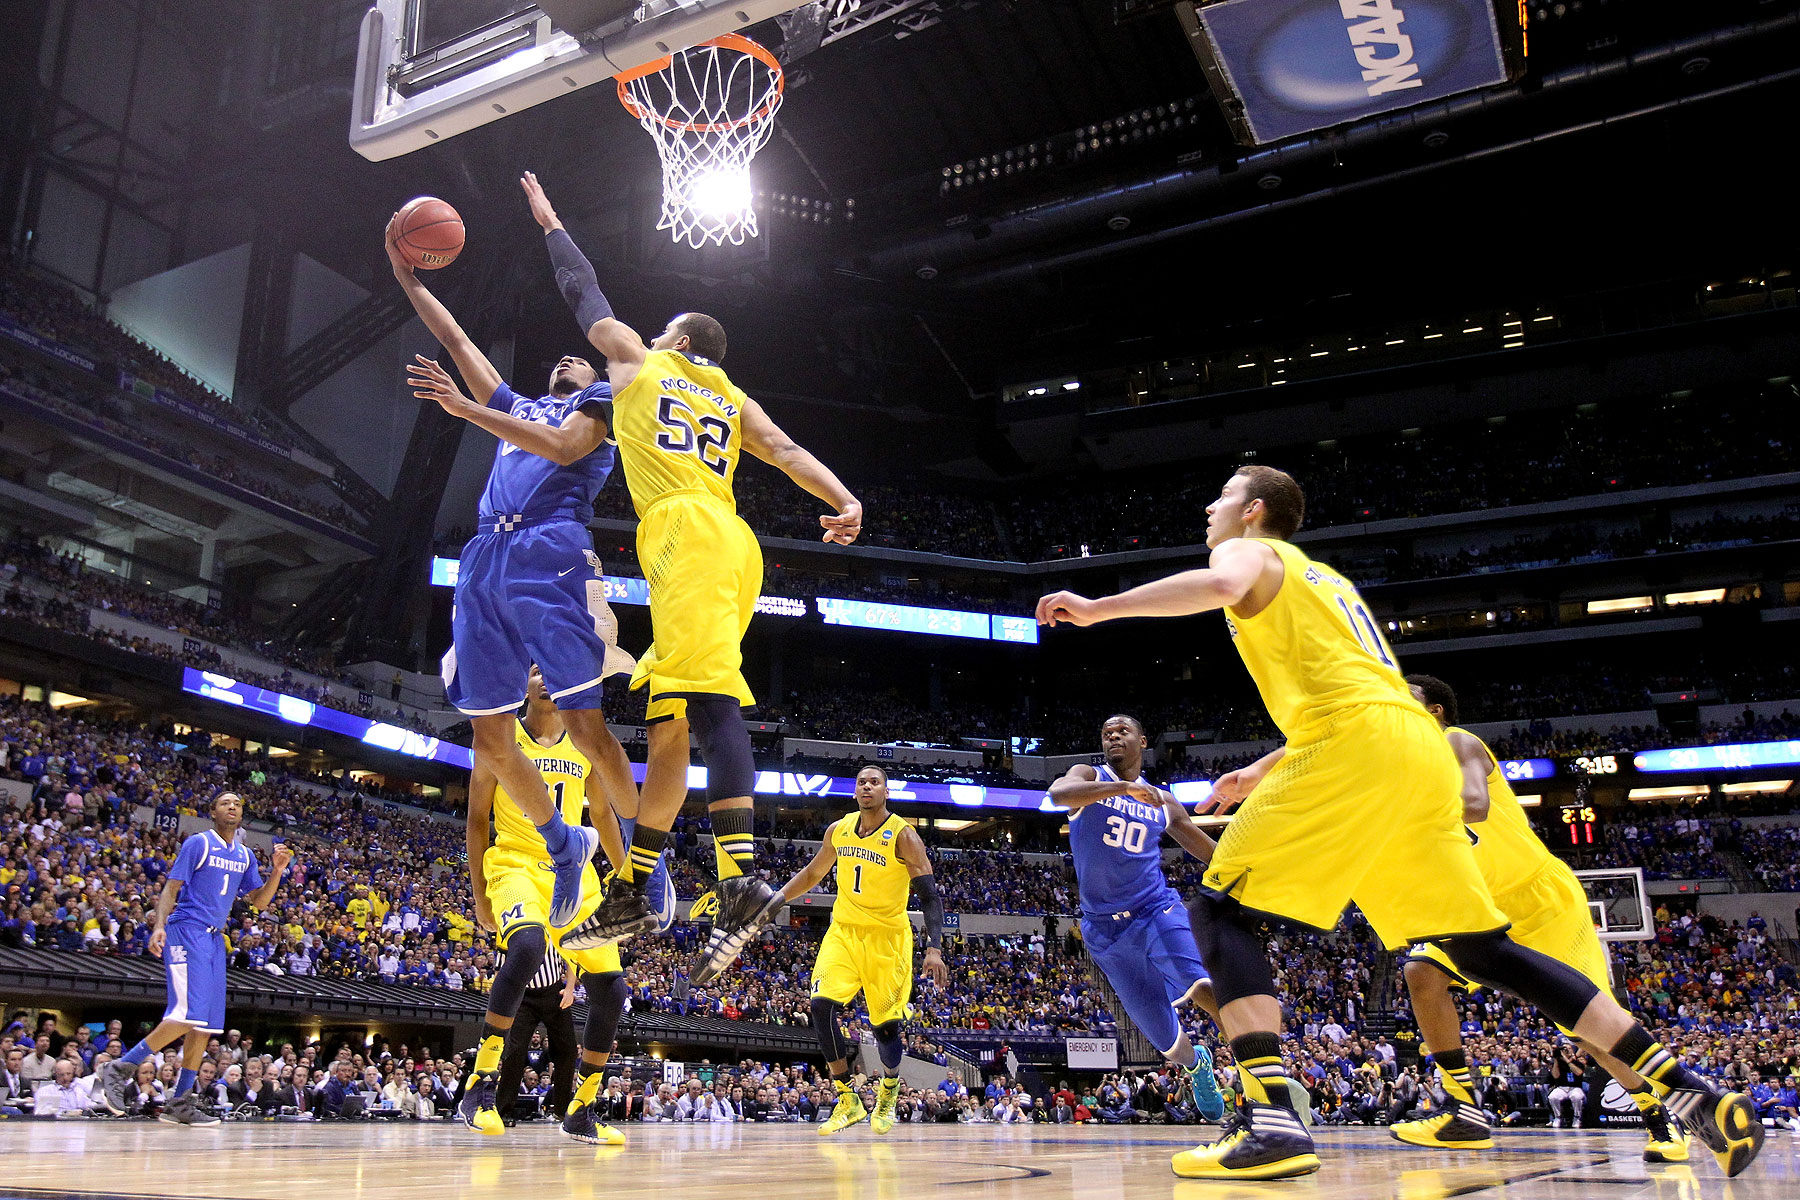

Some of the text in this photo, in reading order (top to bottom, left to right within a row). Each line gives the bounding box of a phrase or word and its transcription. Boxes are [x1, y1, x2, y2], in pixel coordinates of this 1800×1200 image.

[1338, 0, 1423, 97] NCAA
[54, 347, 95, 370] LOCATION
[660, 378, 738, 417] MORGAN
[657, 395, 731, 478] 52
[259, 439, 290, 458] LOCATION
[864, 607, 902, 625] 67%
[1335, 594, 1395, 668] 11
[637, 730, 647, 738] 33
[878, 748, 893, 757] 333
[1669, 750, 1699, 769] 30
[534, 758, 584, 779] VERINES
[1505, 760, 1534, 779] 34
[1096, 795, 1160, 823] ENTUCKY
[155, 814, 178, 829] 128
[1103, 815, 1148, 854] 30
[208, 855, 247, 874] KENTUCKY
[836, 845, 887, 867] WOLVERINES
[220, 873, 230, 896] 1
[853, 864, 862, 894] 1
[500, 902, 525, 928] M
[1068, 1042, 1114, 1053] EMERGENCY EXIT
